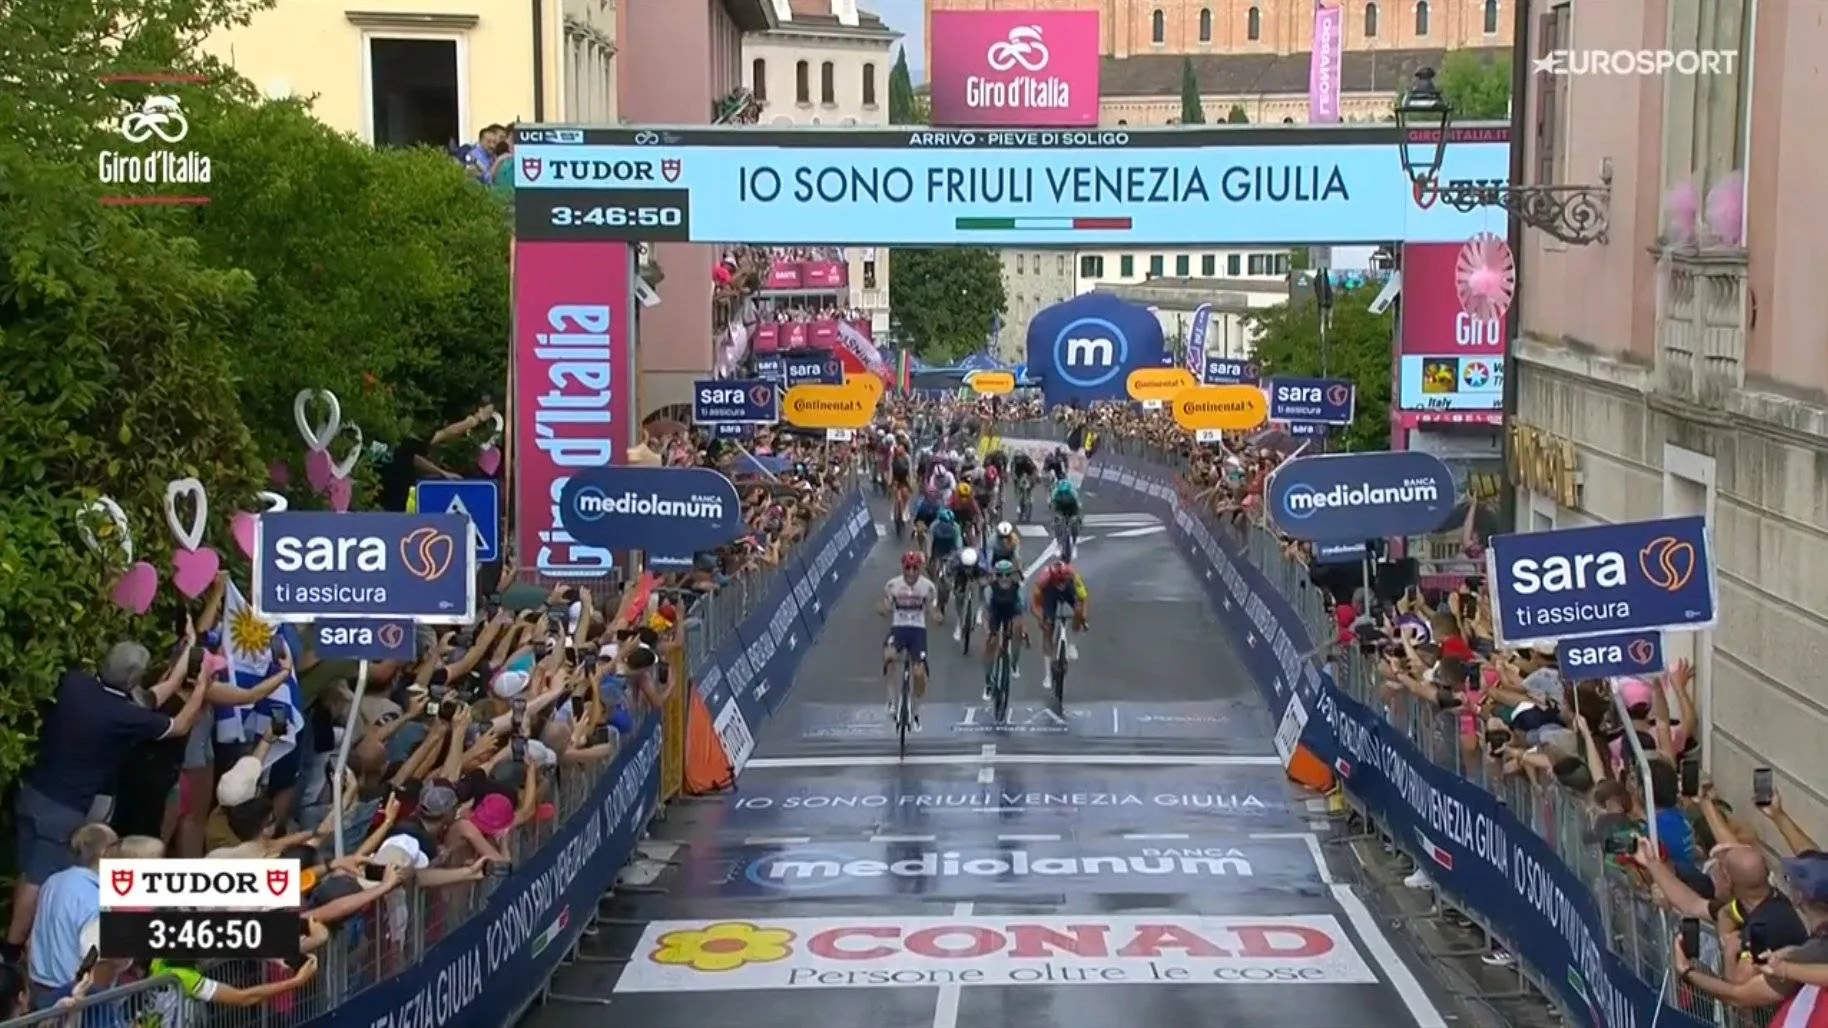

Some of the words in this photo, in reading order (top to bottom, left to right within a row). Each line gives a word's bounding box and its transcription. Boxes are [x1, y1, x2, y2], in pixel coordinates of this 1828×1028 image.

[967, 75, 1004, 108] Giro
[1008, 74, 1069, 108] d'Italia
[520, 130, 543, 142] UCI
[909, 132, 975, 145] ARRIVO
[989, 132, 1037, 145] PIEVE
[1042, 132, 1060, 145] DI
[1065, 132, 1129, 145] SOLIGO
[549, 160, 654, 180] TUDOR
[739, 166, 782, 202] IO
[793, 166, 914, 202] SONO
[927, 166, 1032, 202] FRIULI
[1045, 165, 1209, 203] VENEZIA
[1222, 164, 1350, 202] GIULIA
[551, 206, 682, 226] 3:46:50
[1067, 338, 1113, 366] m
[758, 360, 778, 370] sara
[789, 364, 821, 376] sara
[1209, 361, 1241, 375] sara
[534, 304, 611, 467] d'Italia
[1134, 379, 1178, 389] Continental
[700, 388, 745, 404] sara
[1278, 386, 1322, 403] sara
[1428, 396, 1451, 410] Italy
[709, 408, 746, 416] assicura
[793, 400, 853, 412] Continental
[1183, 401, 1245, 415] Continental
[1285, 407, 1322, 415] assicura
[719, 425, 741, 434] sara
[1293, 425, 1314, 434] sara
[1403, 477, 1436, 486] BANCA
[691, 494, 723, 503] BANCA
[1289, 482, 1437, 510] mediolanum
[580, 492, 723, 519] mediolanum
[275, 536, 386, 571] sara
[1511, 549, 1627, 595] sara
[275, 584, 290, 602] ti
[295, 584, 387, 602] assicura
[1516, 605, 1532, 626] ti
[1537, 601, 1630, 625] assicura
[320, 626, 373, 645] sara
[1568, 644, 1623, 666] sara
[735, 797, 773, 809] IO
[782, 796, 889, 809] SONO
[899, 794, 991, 808] FRIULI
[1002, 793, 1141, 807] VENEZIA
[1153, 793, 1265, 809] GIULIA
[1428, 787, 1474, 851] VENEZIA
[1475, 812, 1508, 879] GIULIA
[1142, 847, 1245, 857] BANCA
[768, 850, 1254, 878] mediolanum
[1514, 843, 1526, 895] IO
[486, 919, 502, 978] IO
[502, 890, 533, 962] SONO
[806, 923, 1335, 960] CONAD
[787, 963, 984, 985] Persone
[1008, 961, 1127, 981] oltre
[1152, 961, 1190, 981] le
[1214, 962, 1325, 981] cose
[436, 944, 482, 1027] GIULIA
